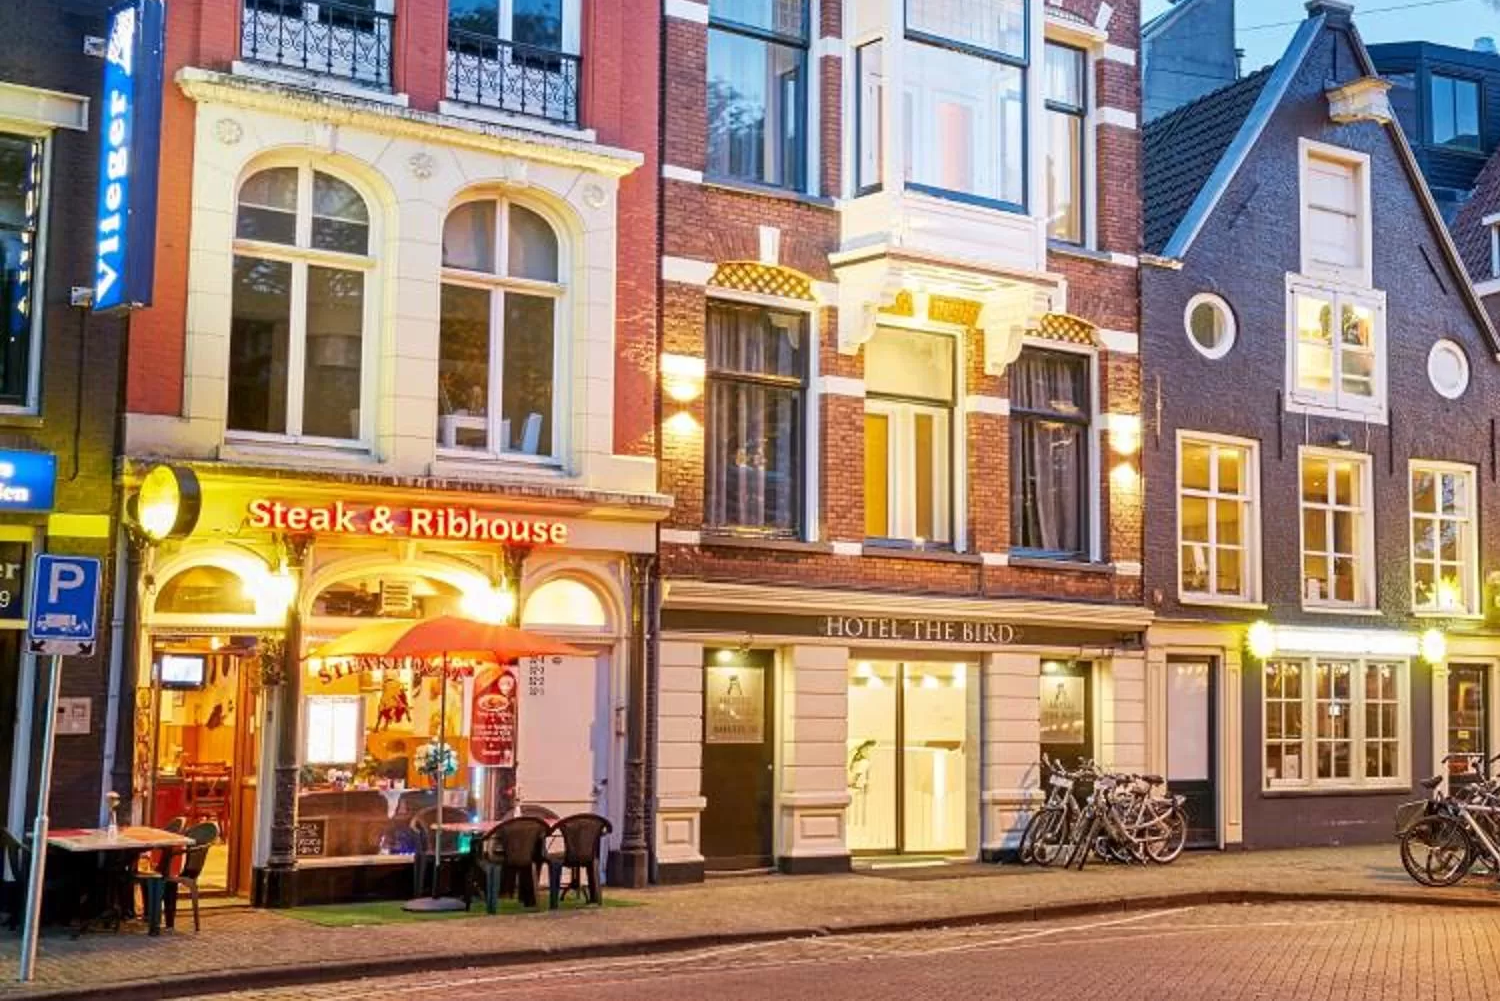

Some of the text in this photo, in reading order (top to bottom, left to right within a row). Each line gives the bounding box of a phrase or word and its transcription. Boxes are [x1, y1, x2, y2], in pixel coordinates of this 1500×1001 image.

[96, 90, 128, 303] Vlieger
[249, 498, 568, 543] Steak & Ribhouse
[48, 561, 85, 603] P
[826, 616, 1014, 644] HOTEL THE BIRD
